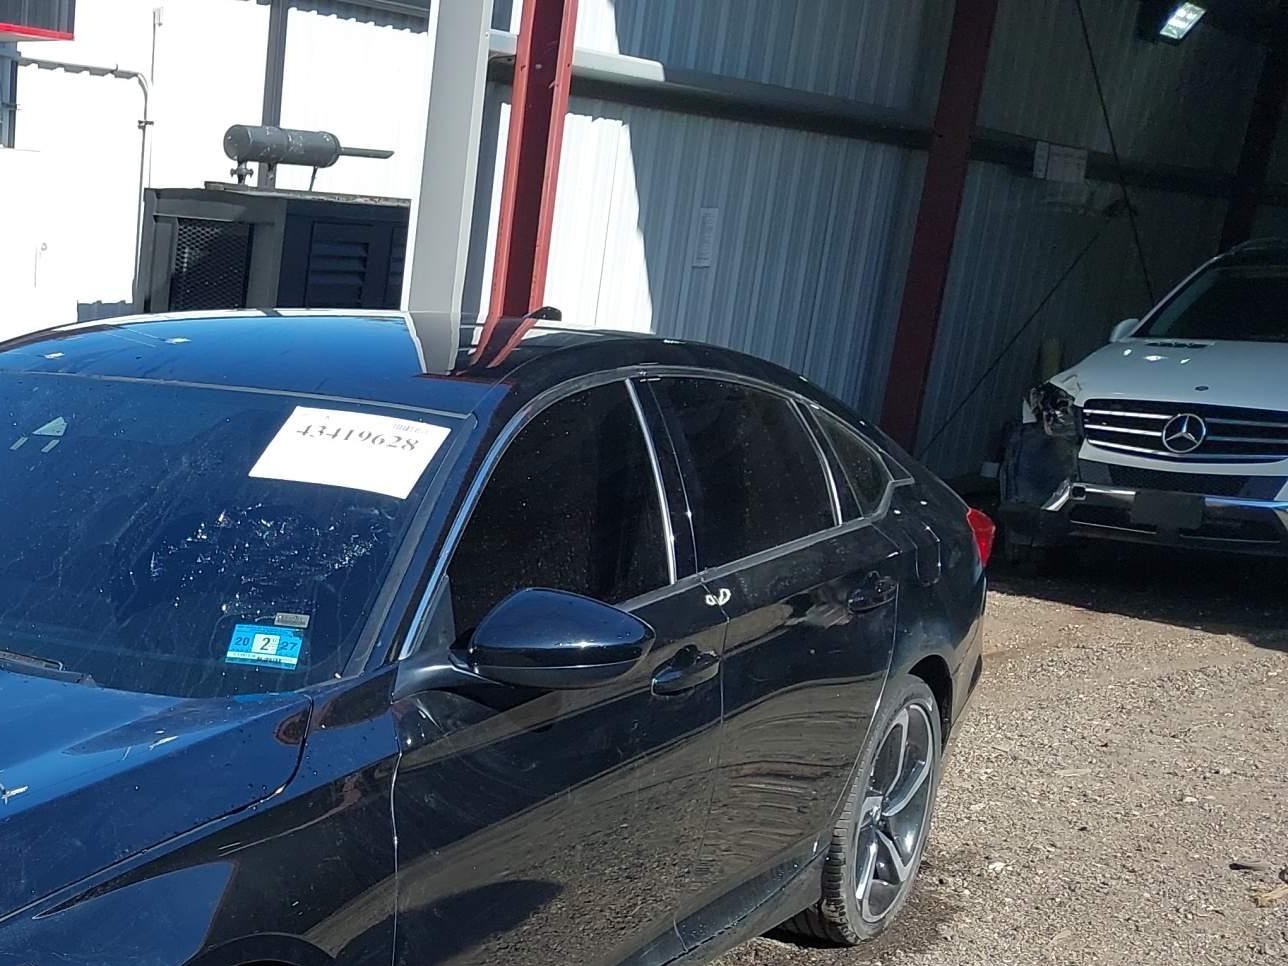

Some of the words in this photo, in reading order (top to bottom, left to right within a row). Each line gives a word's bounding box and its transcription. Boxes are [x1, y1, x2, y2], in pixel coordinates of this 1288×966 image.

[296, 423, 419, 451] 43419628
[234, 636, 250, 646] 20
[259, 637, 271, 651] 2
[280, 641, 298, 651] 27
